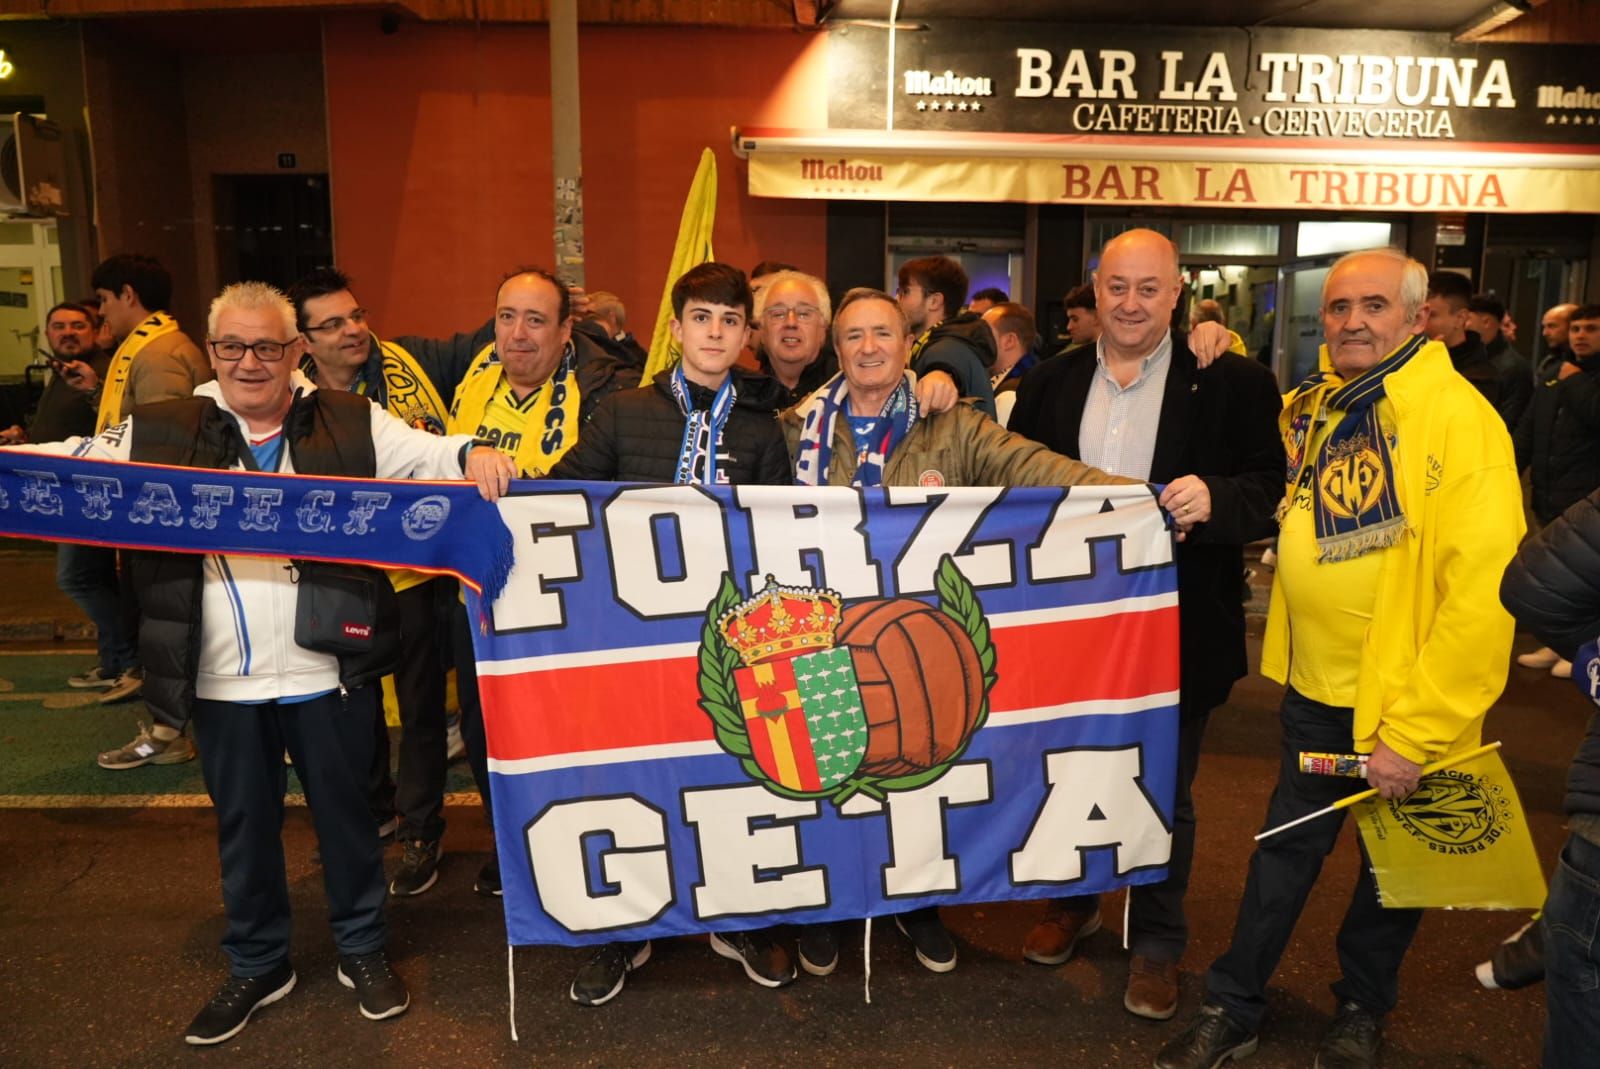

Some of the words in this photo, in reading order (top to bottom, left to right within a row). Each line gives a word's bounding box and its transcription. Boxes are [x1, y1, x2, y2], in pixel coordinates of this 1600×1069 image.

[904, 70, 992, 97] Mahou
[1015, 48, 1138, 99] BAR
[1159, 50, 1238, 101] LA
[1260, 53, 1516, 108] TRIBUNA
[1072, 103, 1246, 134] CAFETERIA
[1264, 107, 1455, 139] CERVECERIA
[801, 159, 883, 182] Mahou
[1061, 164, 1164, 200] BAR
[1194, 167, 1257, 202] LA
[1290, 170, 1509, 208] TRIBUNA
[0, 469, 284, 533] ETAFE
[493, 484, 1174, 634] FORZA
[523, 743, 1174, 934] GETA
[1428, 841, 1486, 854] PENYES
